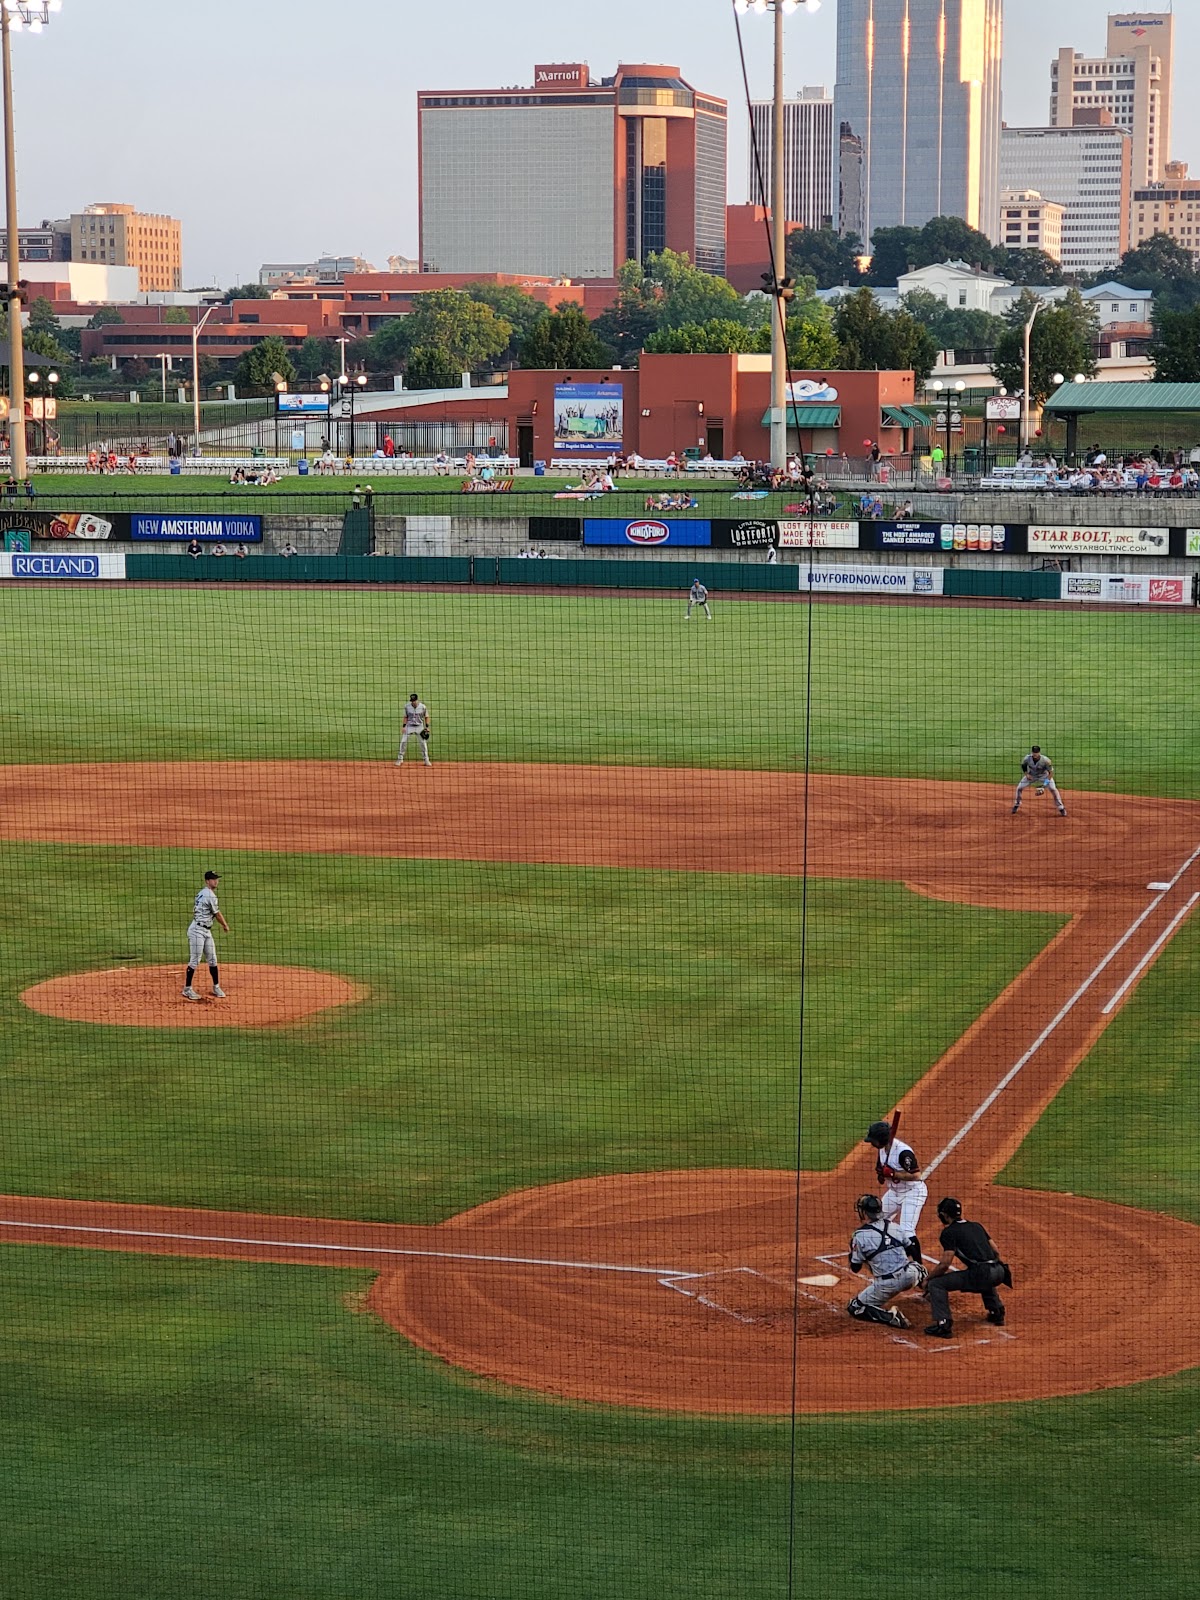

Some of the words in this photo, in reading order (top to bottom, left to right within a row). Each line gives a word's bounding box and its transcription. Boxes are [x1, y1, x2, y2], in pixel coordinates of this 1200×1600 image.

[1138, 19, 1164, 27] America
[536, 70, 579, 82] Marriott
[13, 511, 47, 537] BEAM
[138, 520, 159, 535] NEW
[160, 520, 223, 536] AMSTERDAM
[225, 521, 255, 536] VODKA
[737, 521, 753, 530] LITTLE
[753, 520, 767, 528] ROCK
[630, 524, 665, 540] KINGSFORD
[1032, 530, 1068, 542] STAR
[1072, 530, 1112, 544] BOLT,
[1115, 535, 1134, 543] INC.
[736, 538, 774, 547] BREWING
[1049, 544, 1147, 552] WWW.STARBOLTINC.COM
[16, 558, 95, 574] RICELAND
[807, 572, 906, 586] BUYFORDNOW.COM
[915, 571, 932, 579] BUILT
